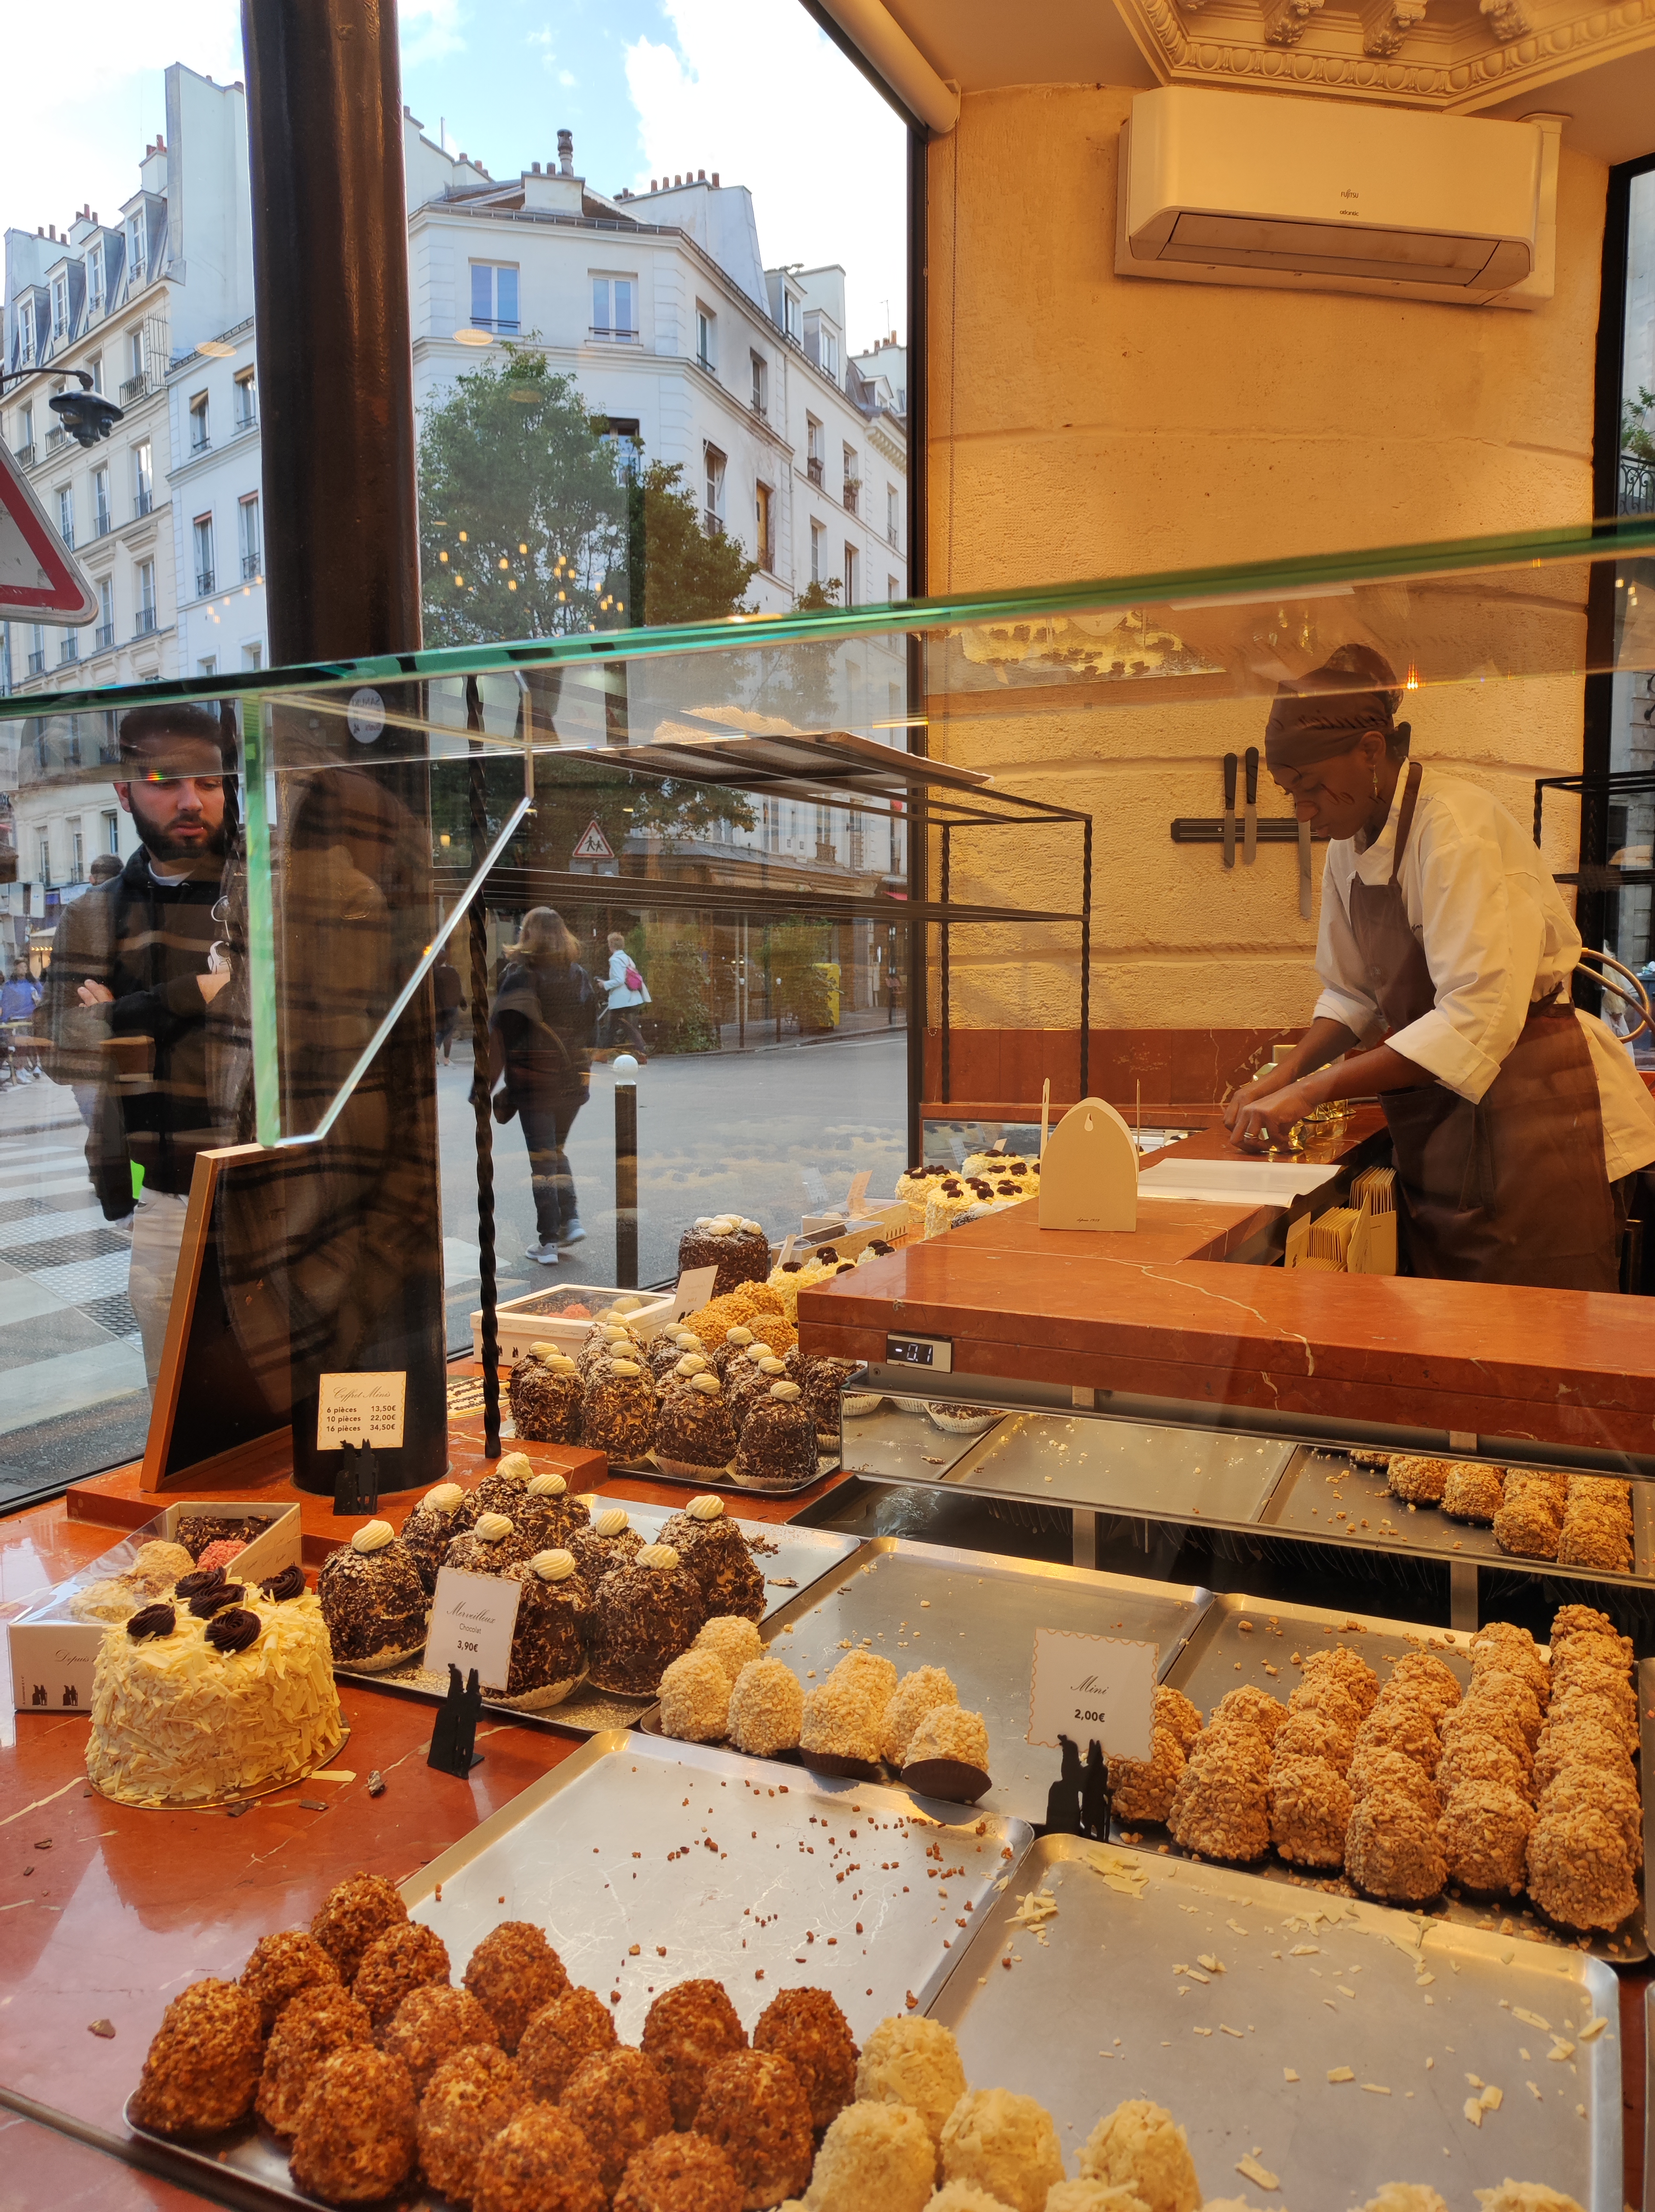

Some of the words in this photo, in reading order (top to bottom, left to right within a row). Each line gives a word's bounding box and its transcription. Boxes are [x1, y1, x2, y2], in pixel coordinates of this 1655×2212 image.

[1340, 189, 1359, 199] FUJITSU
[333, 1387, 363, 1402] Coffret
[363, 1386, 390, 1398] Minis
[338, 1415, 361, 1423] pièces
[447, 1601, 496, 1624] Merveilleux
[459, 1623, 481, 1634] Chocolat
[457, 1640, 479, 1652] 3,90€
[54, 1649, 89, 1666] Depuis
[1070, 1675, 1109, 1694] Mini
[1074, 1709, 1105, 1722] 2,00€
